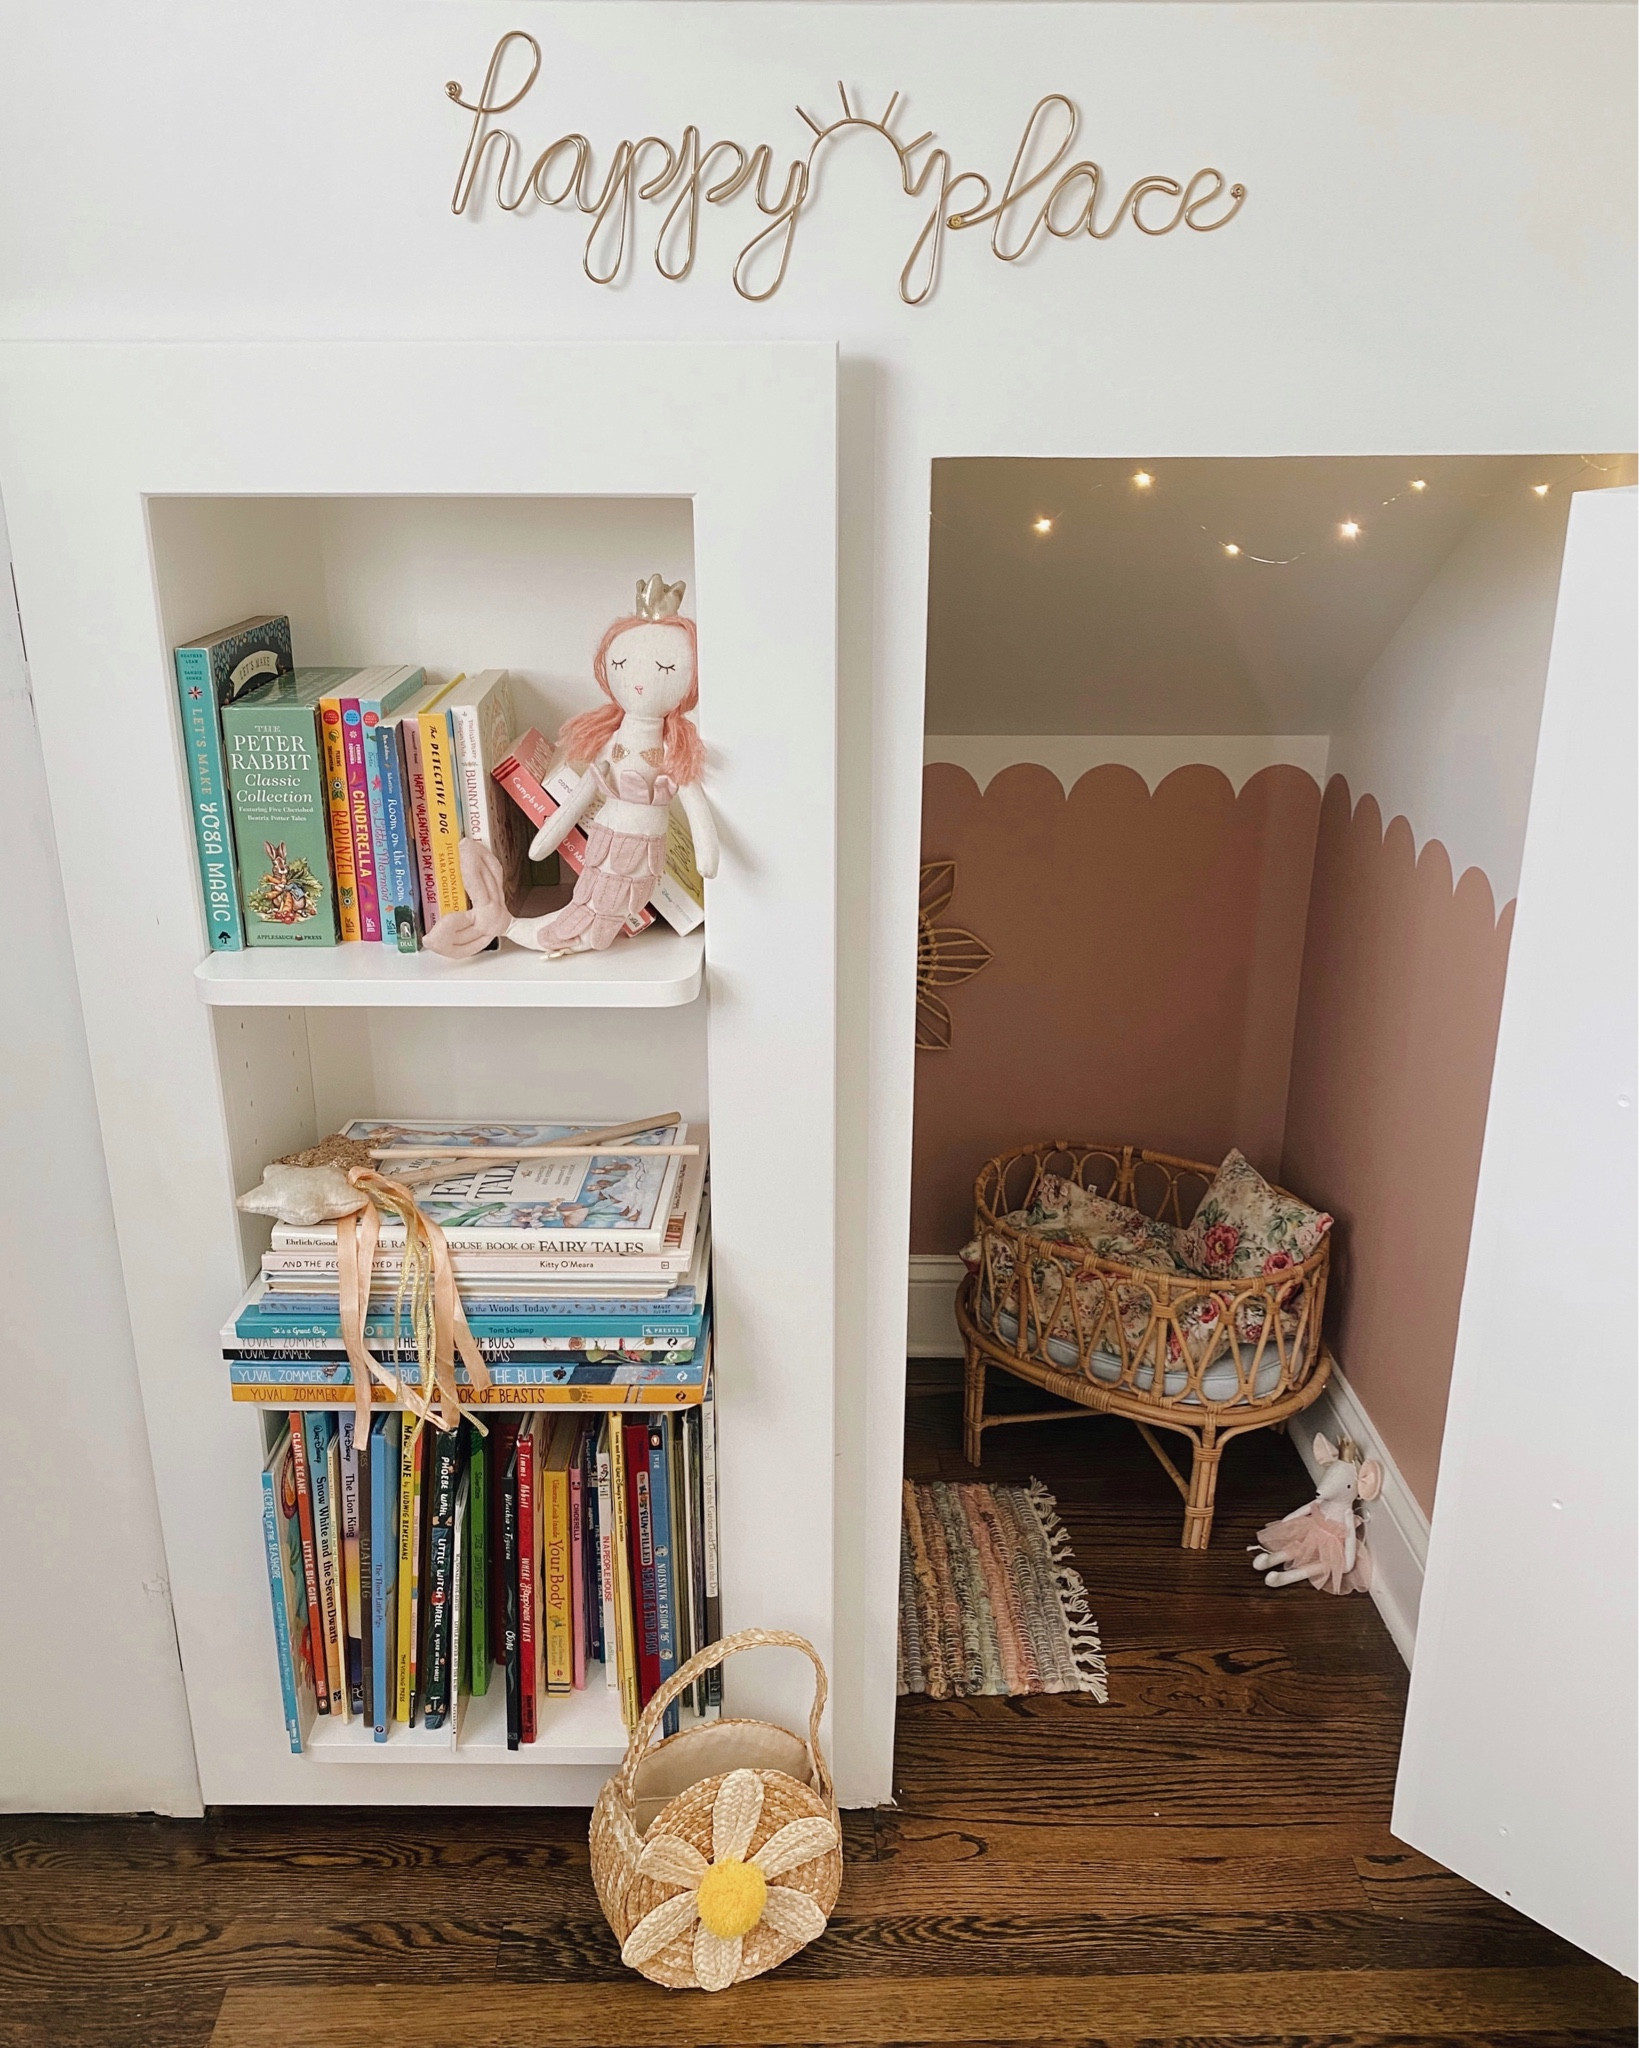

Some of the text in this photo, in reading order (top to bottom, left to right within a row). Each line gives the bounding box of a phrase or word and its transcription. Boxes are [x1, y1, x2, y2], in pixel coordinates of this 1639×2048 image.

[445, 30, 1246, 304] happy place
[239, 656, 271, 680] LET'S MAKE
[254, 725, 281, 733] THE
[233, 734, 307, 752] PETER
[230, 753, 312, 771] RABBIT
[244, 773, 301, 787] Classic
[429, 725, 450, 835] The DETECTIVE DOG
[465, 769, 479, 809] BUNNY
[236, 790, 313, 803] Collection
[512, 776, 546, 814] Campbell
[192, 708, 231, 922] LET'S MAKE YOGA MAGIC
[238, 806, 268, 814] Featuring
[331, 810, 353, 878] RAPUNZEL
[352, 790, 372, 878] CINDERELLA
[413, 773, 425, 801] HAPPY
[424, 873, 437, 904] MOUSE!
[371, 799, 393, 902] The Little Mermaid
[387, 799, 406, 901] Room on the Broom
[438, 853, 450, 909] SARA OGILVIE
[446, 842, 460, 912] JULIA DONALDSO
[446, 1240, 644, 1255] HOUSE BOOK OF FAIRY TALES
[282, 1260, 594, 1270] AND THE Kitty O'Meara
[489, 1303, 550, 1315] Woods Today
[241, 1337, 515, 1349] YUVAL ZOMMER THE BUGS
[292, 1326, 311, 1334] Great
[312, 1326, 327, 1336] Big
[505, 1327, 534, 1335] Schamp
[238, 1350, 269, 1360] YUVAL
[272, 1350, 311, 1360] ZOMMER
[405, 1350, 419, 1362] BIG
[238, 1368, 553, 1385] YUVAL ZOMMER BIG BLUE
[250, 1388, 545, 1403] YUVAL ZOMMER OF BEASTS
[705, 1443, 713, 1461] Neal
[439, 1456, 450, 1517] PHOEBE WAHL
[706, 1474, 715, 1486] Up
[345, 1473, 357, 1538] The Lion King
[520, 1484, 530, 1509] Abbott
[292, 1432, 318, 1606] CLAIRE KEANE LITTLE BIG GIRL
[401, 1490, 410, 1561] LUDWIG BEMELMANS
[552, 1518, 560, 1538] Inside
[573, 1503, 581, 1542] CINDERELLA
[707, 1505, 716, 1530] Garden
[263, 1487, 273, 1520] SECRETS
[268, 1541, 281, 1579] SEASHORE
[602, 1535, 610, 1543] IN
[639, 1509, 651, 1564] FUN-FILLED
[708, 1530, 716, 1542] and
[316, 1476, 337, 1645] Snow White and the Seven Dwarfs
[548, 1540, 565, 1573] Your
[602, 1550, 611, 1577] PEOPLE
[708, 1543, 717, 1563] Down
[360, 1539, 371, 1599] WAITING
[520, 1557, 531, 1584] WHERE
[709, 1571, 717, 1581] the
[710, 1563, 716, 1571] in
[375, 1562, 384, 1628] The Three Little Pigs
[434, 1538, 447, 1628] LITTLE WITCH HAZEL
[549, 1574, 565, 1610] Body
[603, 1577, 612, 1602] HOUSE
[642, 1567, 655, 1601] SEARCH
[656, 1563, 668, 1601] MANSION
[710, 1582, 718, 1595] Dirt
[520, 1583, 532, 1622] Happiness
[644, 1601, 656, 1609] &
[644, 1609, 656, 1630] FIND
[658, 1603, 669, 1630] MOUSE
[522, 1622, 532, 1643] LIVES
[645, 1630, 658, 1656] BOOK
